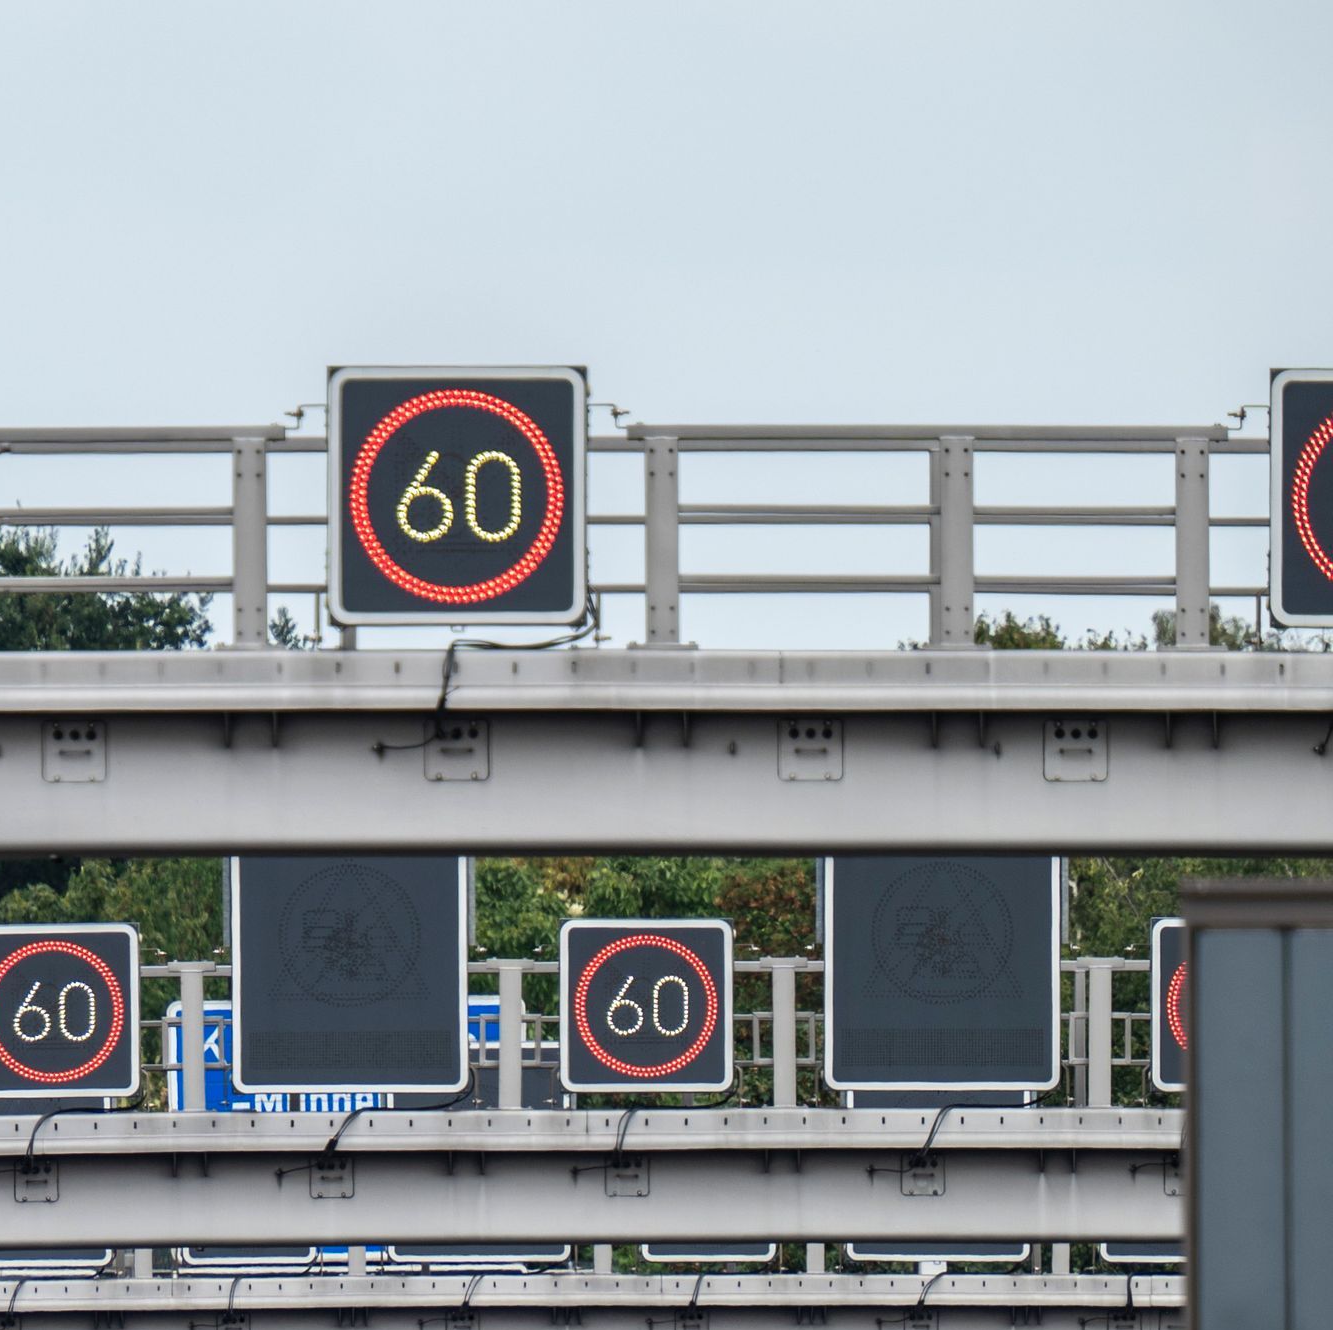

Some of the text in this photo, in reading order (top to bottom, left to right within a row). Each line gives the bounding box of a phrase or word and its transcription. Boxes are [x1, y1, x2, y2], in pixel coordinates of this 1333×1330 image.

[396, 448, 522, 543] 60
[13, 980, 96, 1042] 60
[606, 974, 689, 1036] 60
